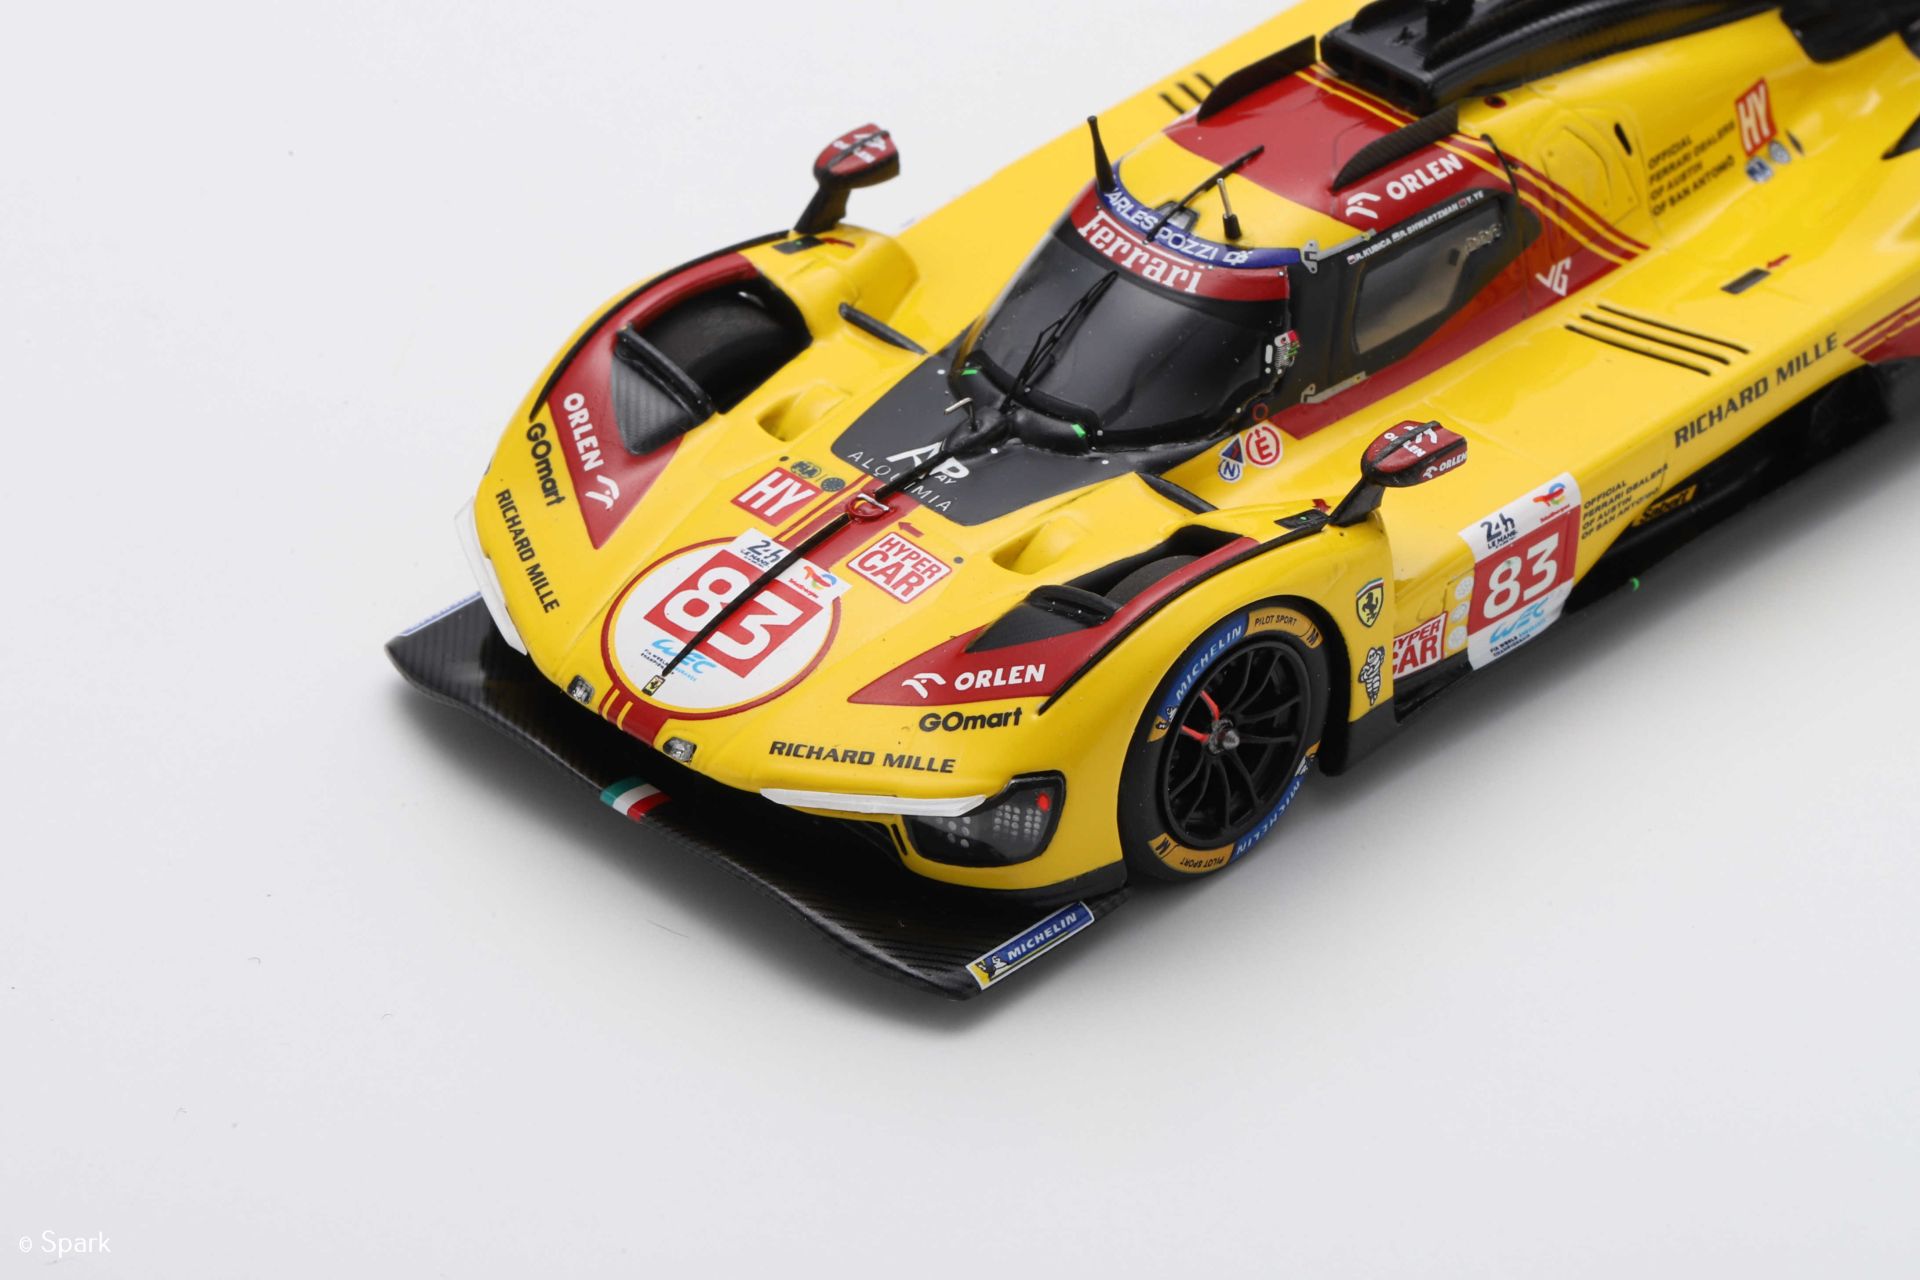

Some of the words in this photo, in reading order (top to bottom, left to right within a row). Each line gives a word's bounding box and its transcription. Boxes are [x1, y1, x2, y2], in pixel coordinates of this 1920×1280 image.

[1738, 83, 1770, 152] HY
[1386, 153, 1463, 200] ORLEN
[1078, 209, 1205, 294] Ferrari
[1154, 226, 1219, 262] POZZI
[1675, 377, 1769, 448] RICHARD
[1776, 332, 1839, 386] MILLE
[563, 392, 604, 471] ORLEN
[526, 422, 566, 506] GOmart
[739, 471, 815, 518] HY
[1582, 518, 1596, 530] OF
[1597, 496, 1632, 521] AUSTIN
[1583, 491, 1624, 520] FERRARI
[1626, 463, 1668, 494] DEALERS
[1583, 480, 1626, 509] OFFICIAL
[495, 488, 536, 562] RICHARD
[525, 563, 560, 613] MILLE
[1480, 513, 1515, 543] 24h
[1581, 527, 1595, 540] OF
[857, 551, 927, 599] CAR
[879, 537, 943, 580] HYPER
[1483, 532, 1560, 620] 83
[664, 566, 804, 660] 83
[1254, 616, 1273, 627] PILOT
[1275, 614, 1297, 626] SPORT
[954, 663, 1046, 691] ORLEN
[1175, 625, 1242, 700] MICHELIN
[919, 707, 1023, 733] GOmart
[769, 740, 875, 766] RICHARD
[882, 753, 956, 773] MILLE
[1237, 782, 1300, 854] MICHELIN
[1180, 854, 1205, 868] SPORT
[1006, 912, 1077, 961] MICHELIN
